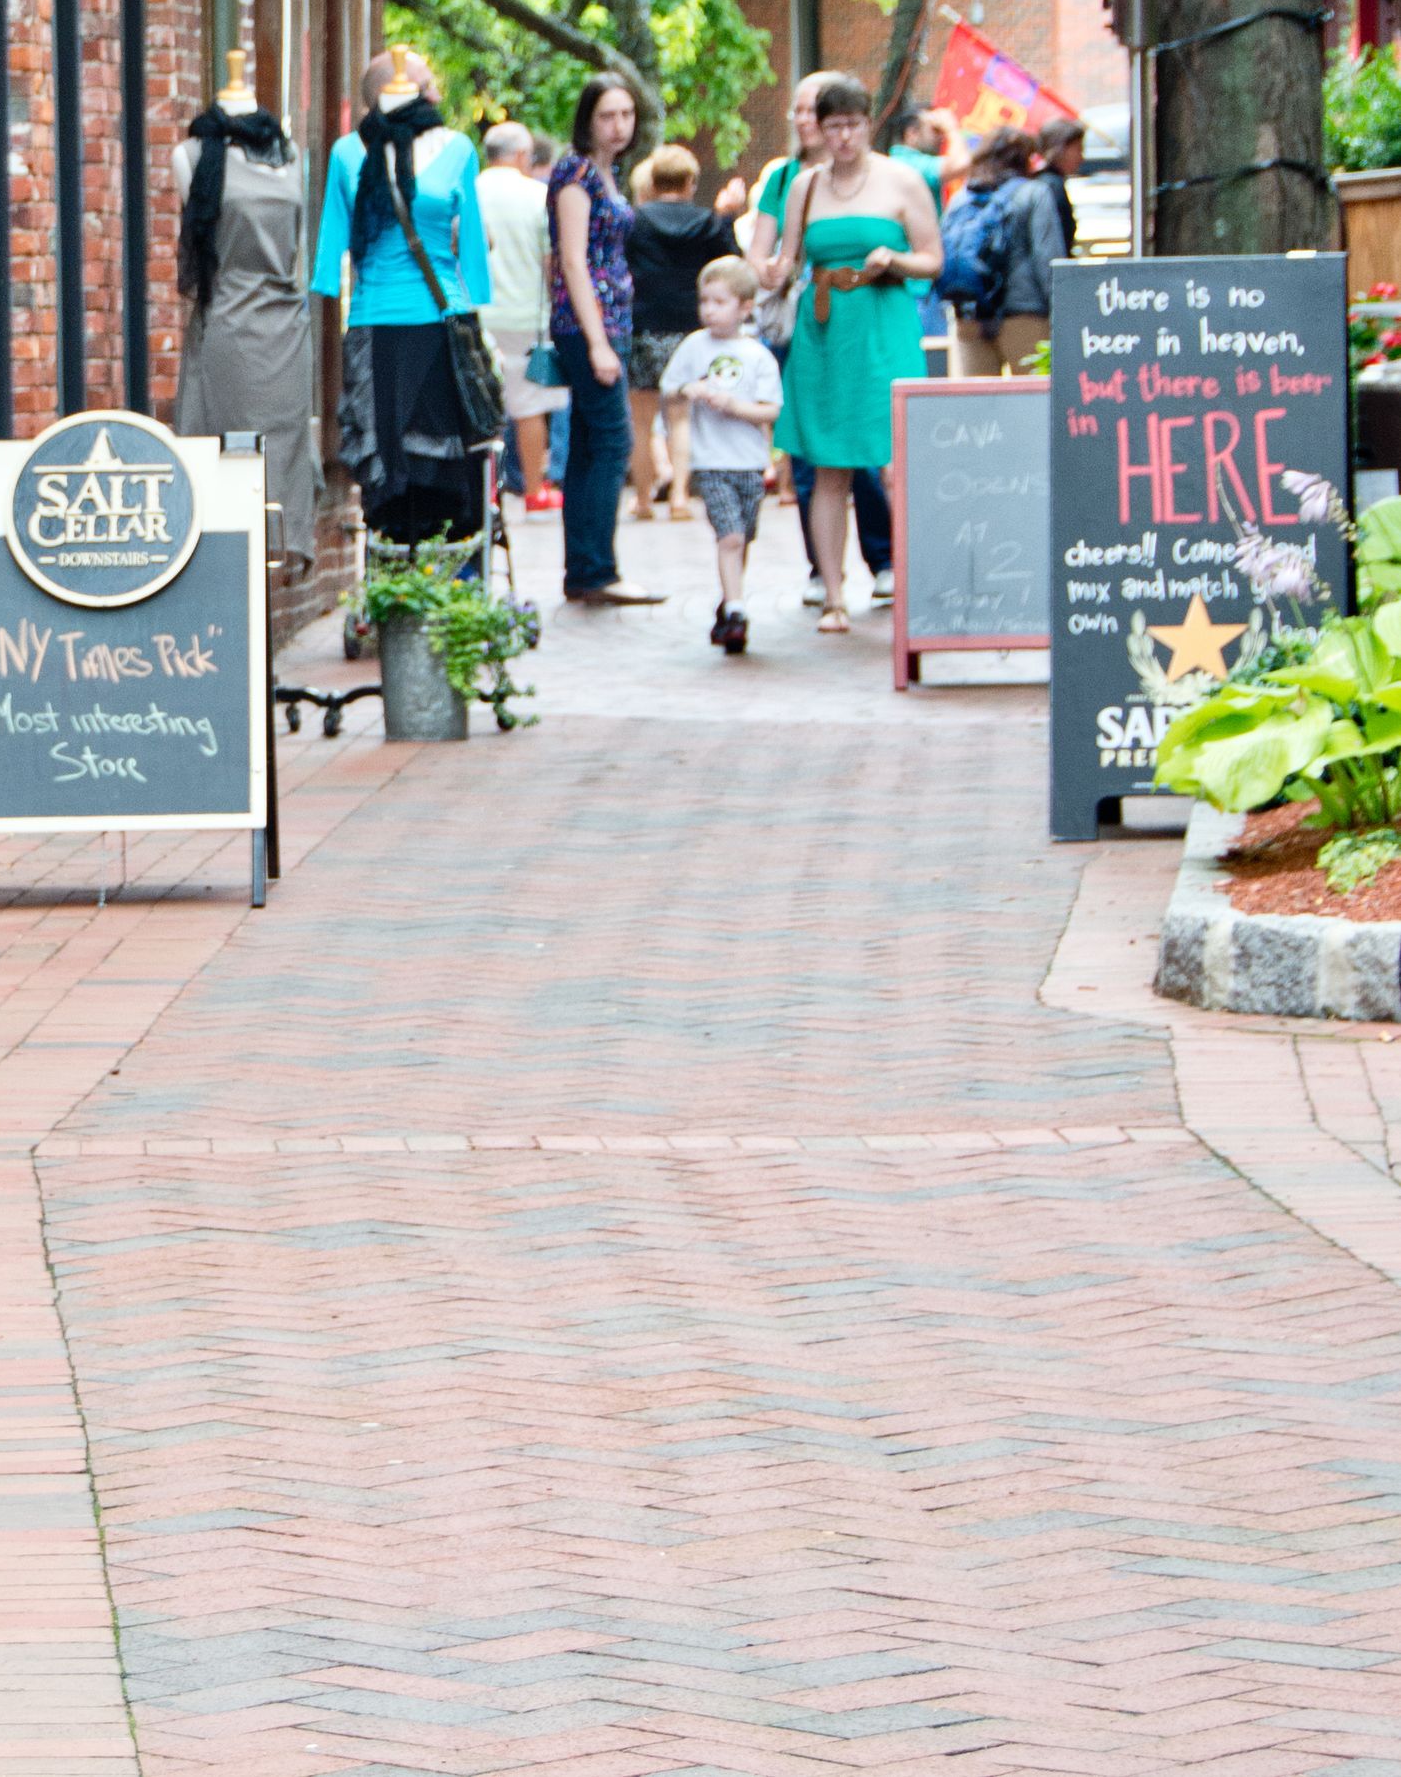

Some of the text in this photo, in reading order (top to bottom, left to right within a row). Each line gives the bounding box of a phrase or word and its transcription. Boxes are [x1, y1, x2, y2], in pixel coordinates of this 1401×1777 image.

[1095, 276, 1266, 317] there is no
[1081, 315, 1305, 359] beer in heaven,
[1079, 361, 1334, 406] but there is beer
[1066, 407, 1299, 526] in HERE
[36, 471, 175, 520] SALT
[27, 510, 174, 548] CELLAR
[1064, 530, 1158, 568] cheers!!
[56, 550, 150, 569] DOWNSTAIRS
[1066, 578, 1112, 605] mix
[1120, 568, 1167, 602] and
[1167, 568, 1239, 604] match
[1067, 612, 1120, 636] own
[56, 630, 154, 685] Times
[69, 701, 219, 758] interesting
[49, 740, 149, 784] Store
